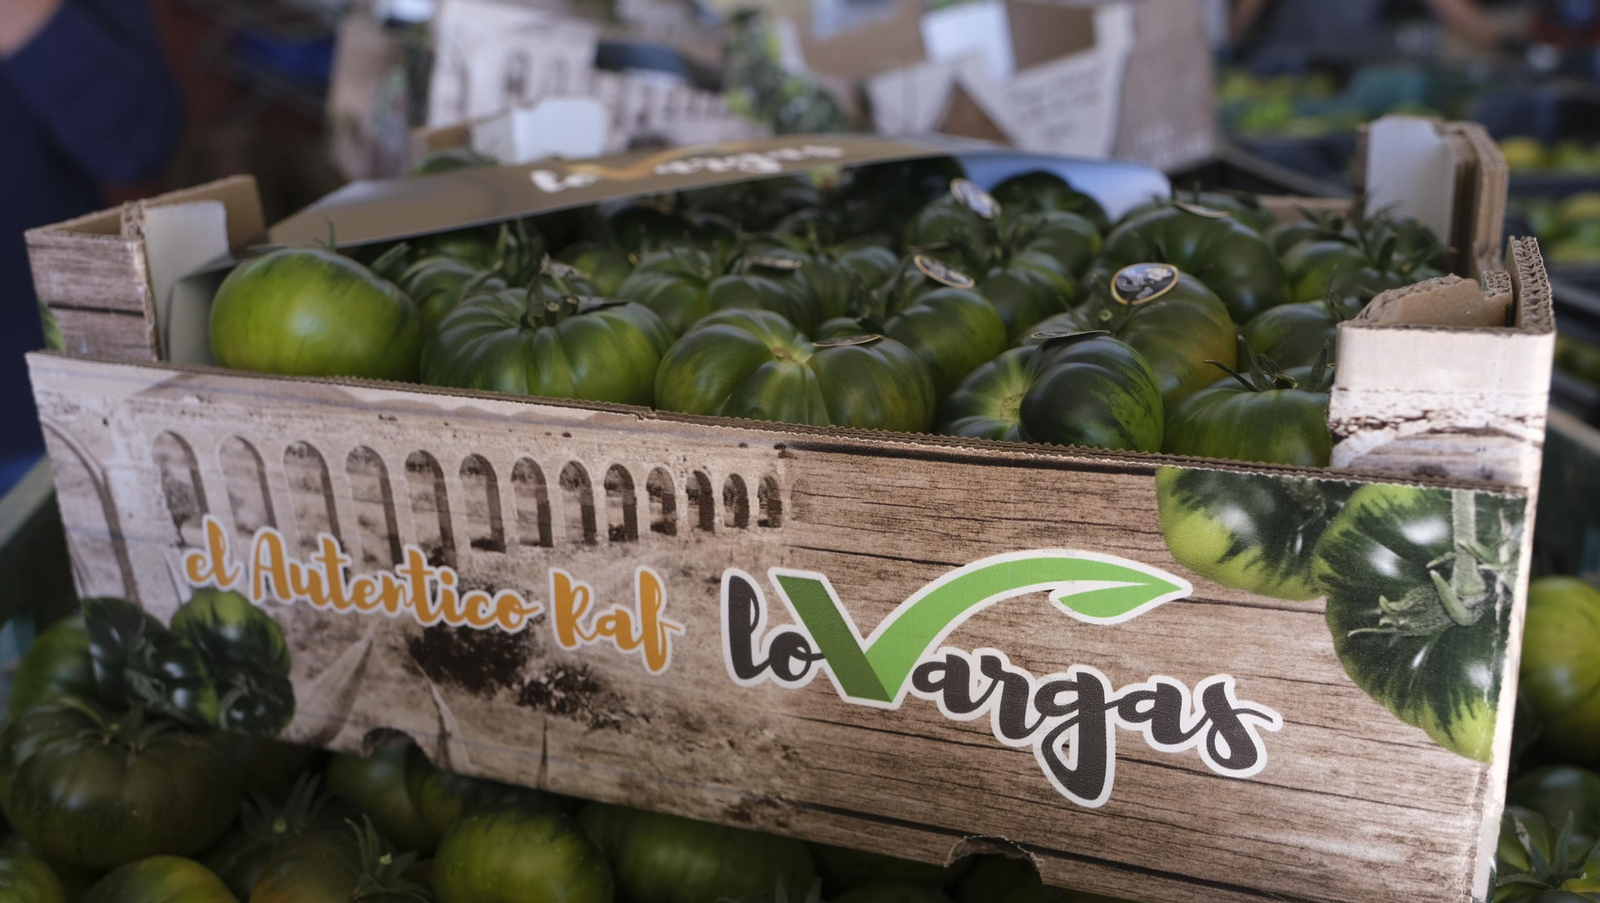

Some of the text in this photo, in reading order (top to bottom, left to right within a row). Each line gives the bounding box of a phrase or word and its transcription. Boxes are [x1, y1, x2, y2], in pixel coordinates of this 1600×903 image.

[186, 517, 682, 672] el Autentico Raf
